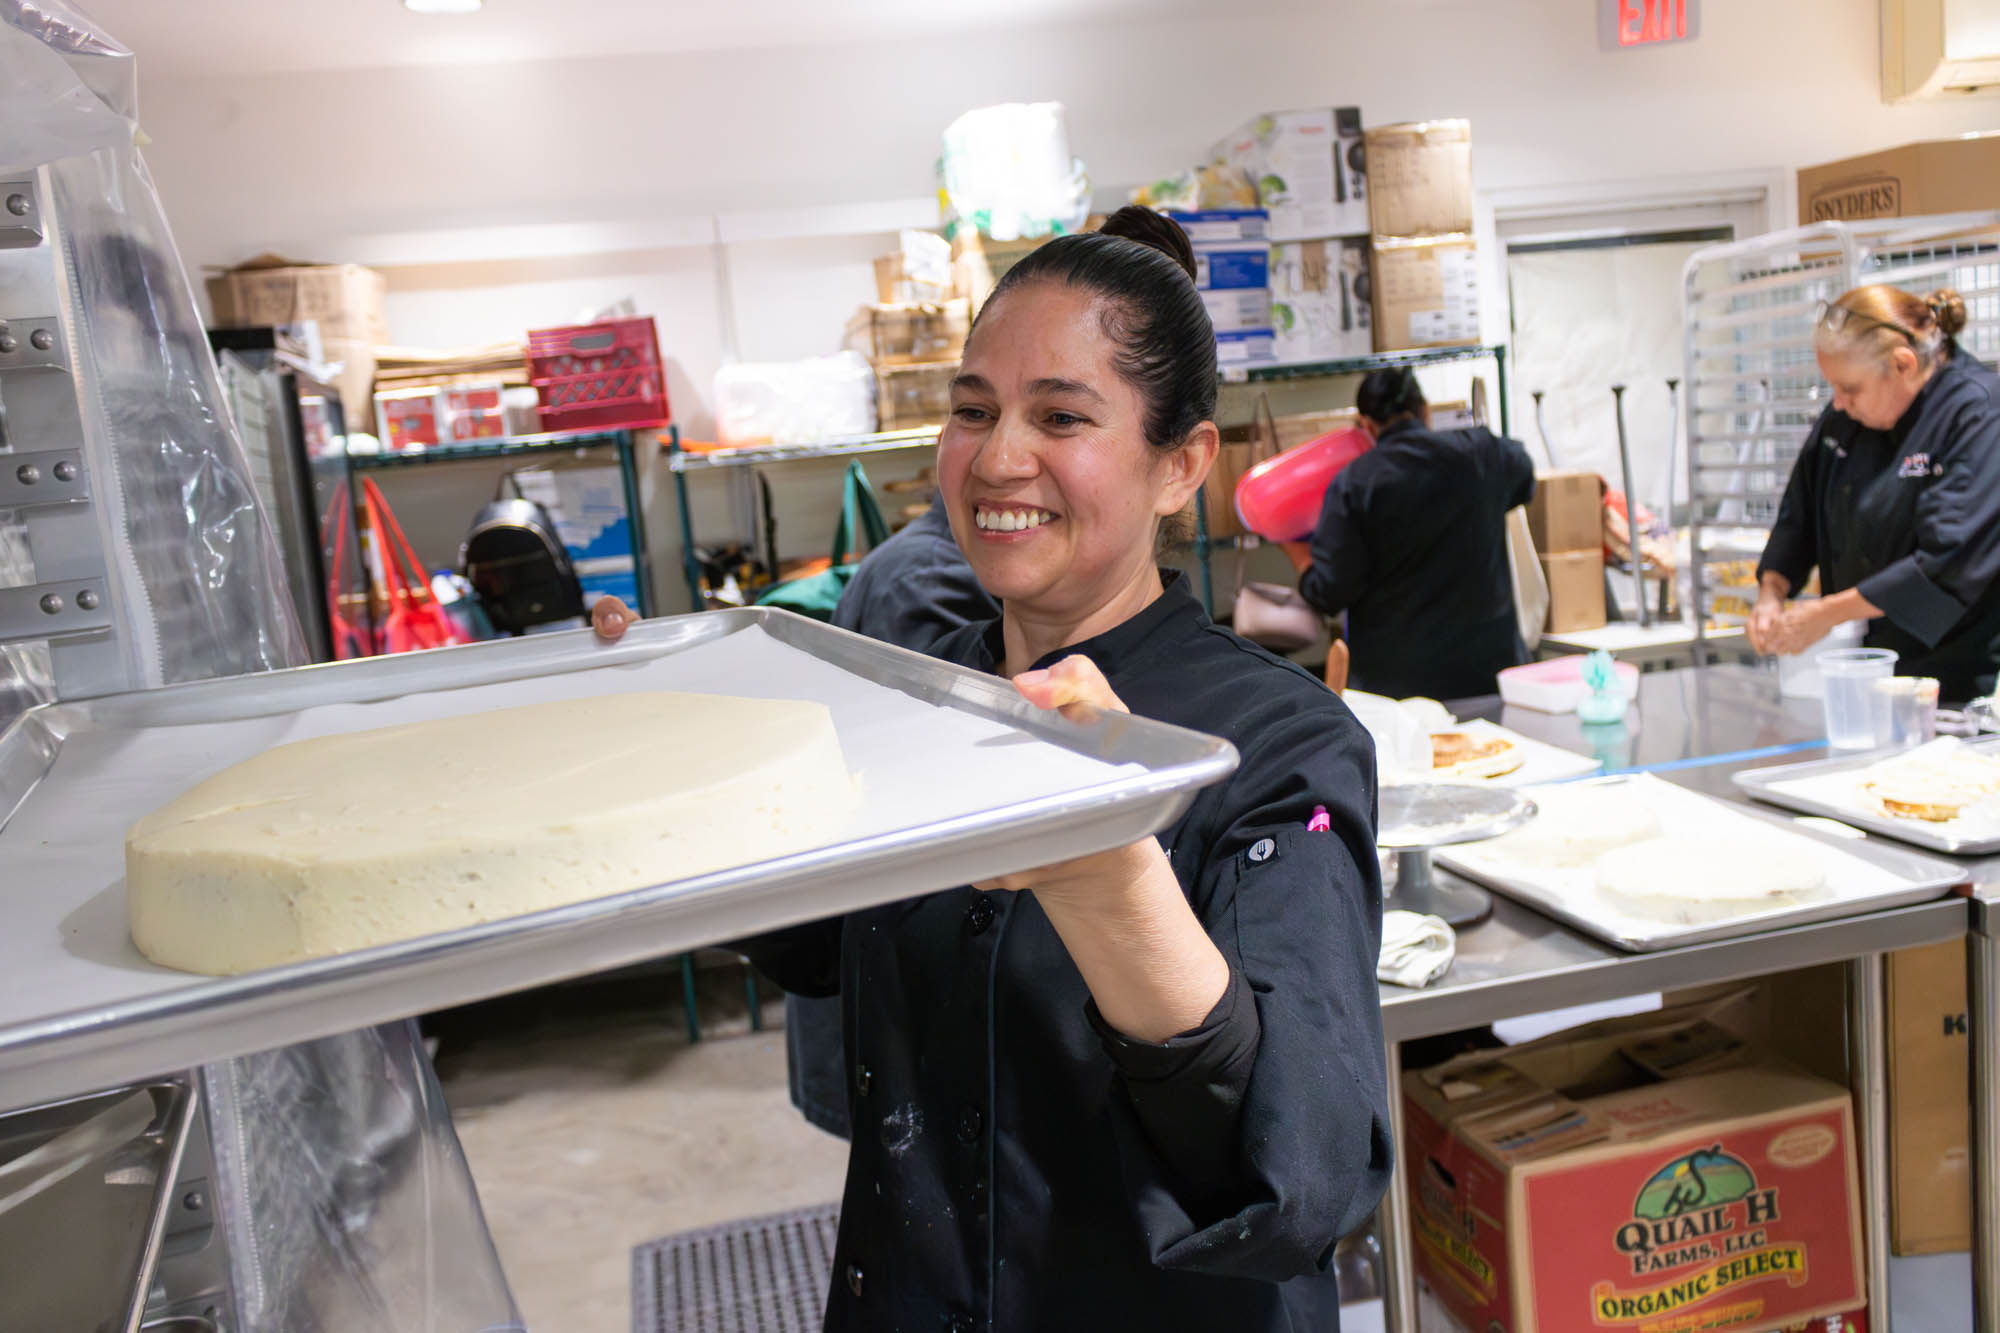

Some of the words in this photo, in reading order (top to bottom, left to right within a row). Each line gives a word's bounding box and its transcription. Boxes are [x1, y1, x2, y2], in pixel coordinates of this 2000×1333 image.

[1616, 1207, 1734, 1255] QUAIL
[1747, 1189, 1778, 1224] H
[1634, 1243, 1718, 1273] FARMS,
[1725, 1231, 1765, 1254] LLC
[1602, 1274, 1710, 1318] ORGANIC
[1716, 1250, 1798, 1286] SELECT
